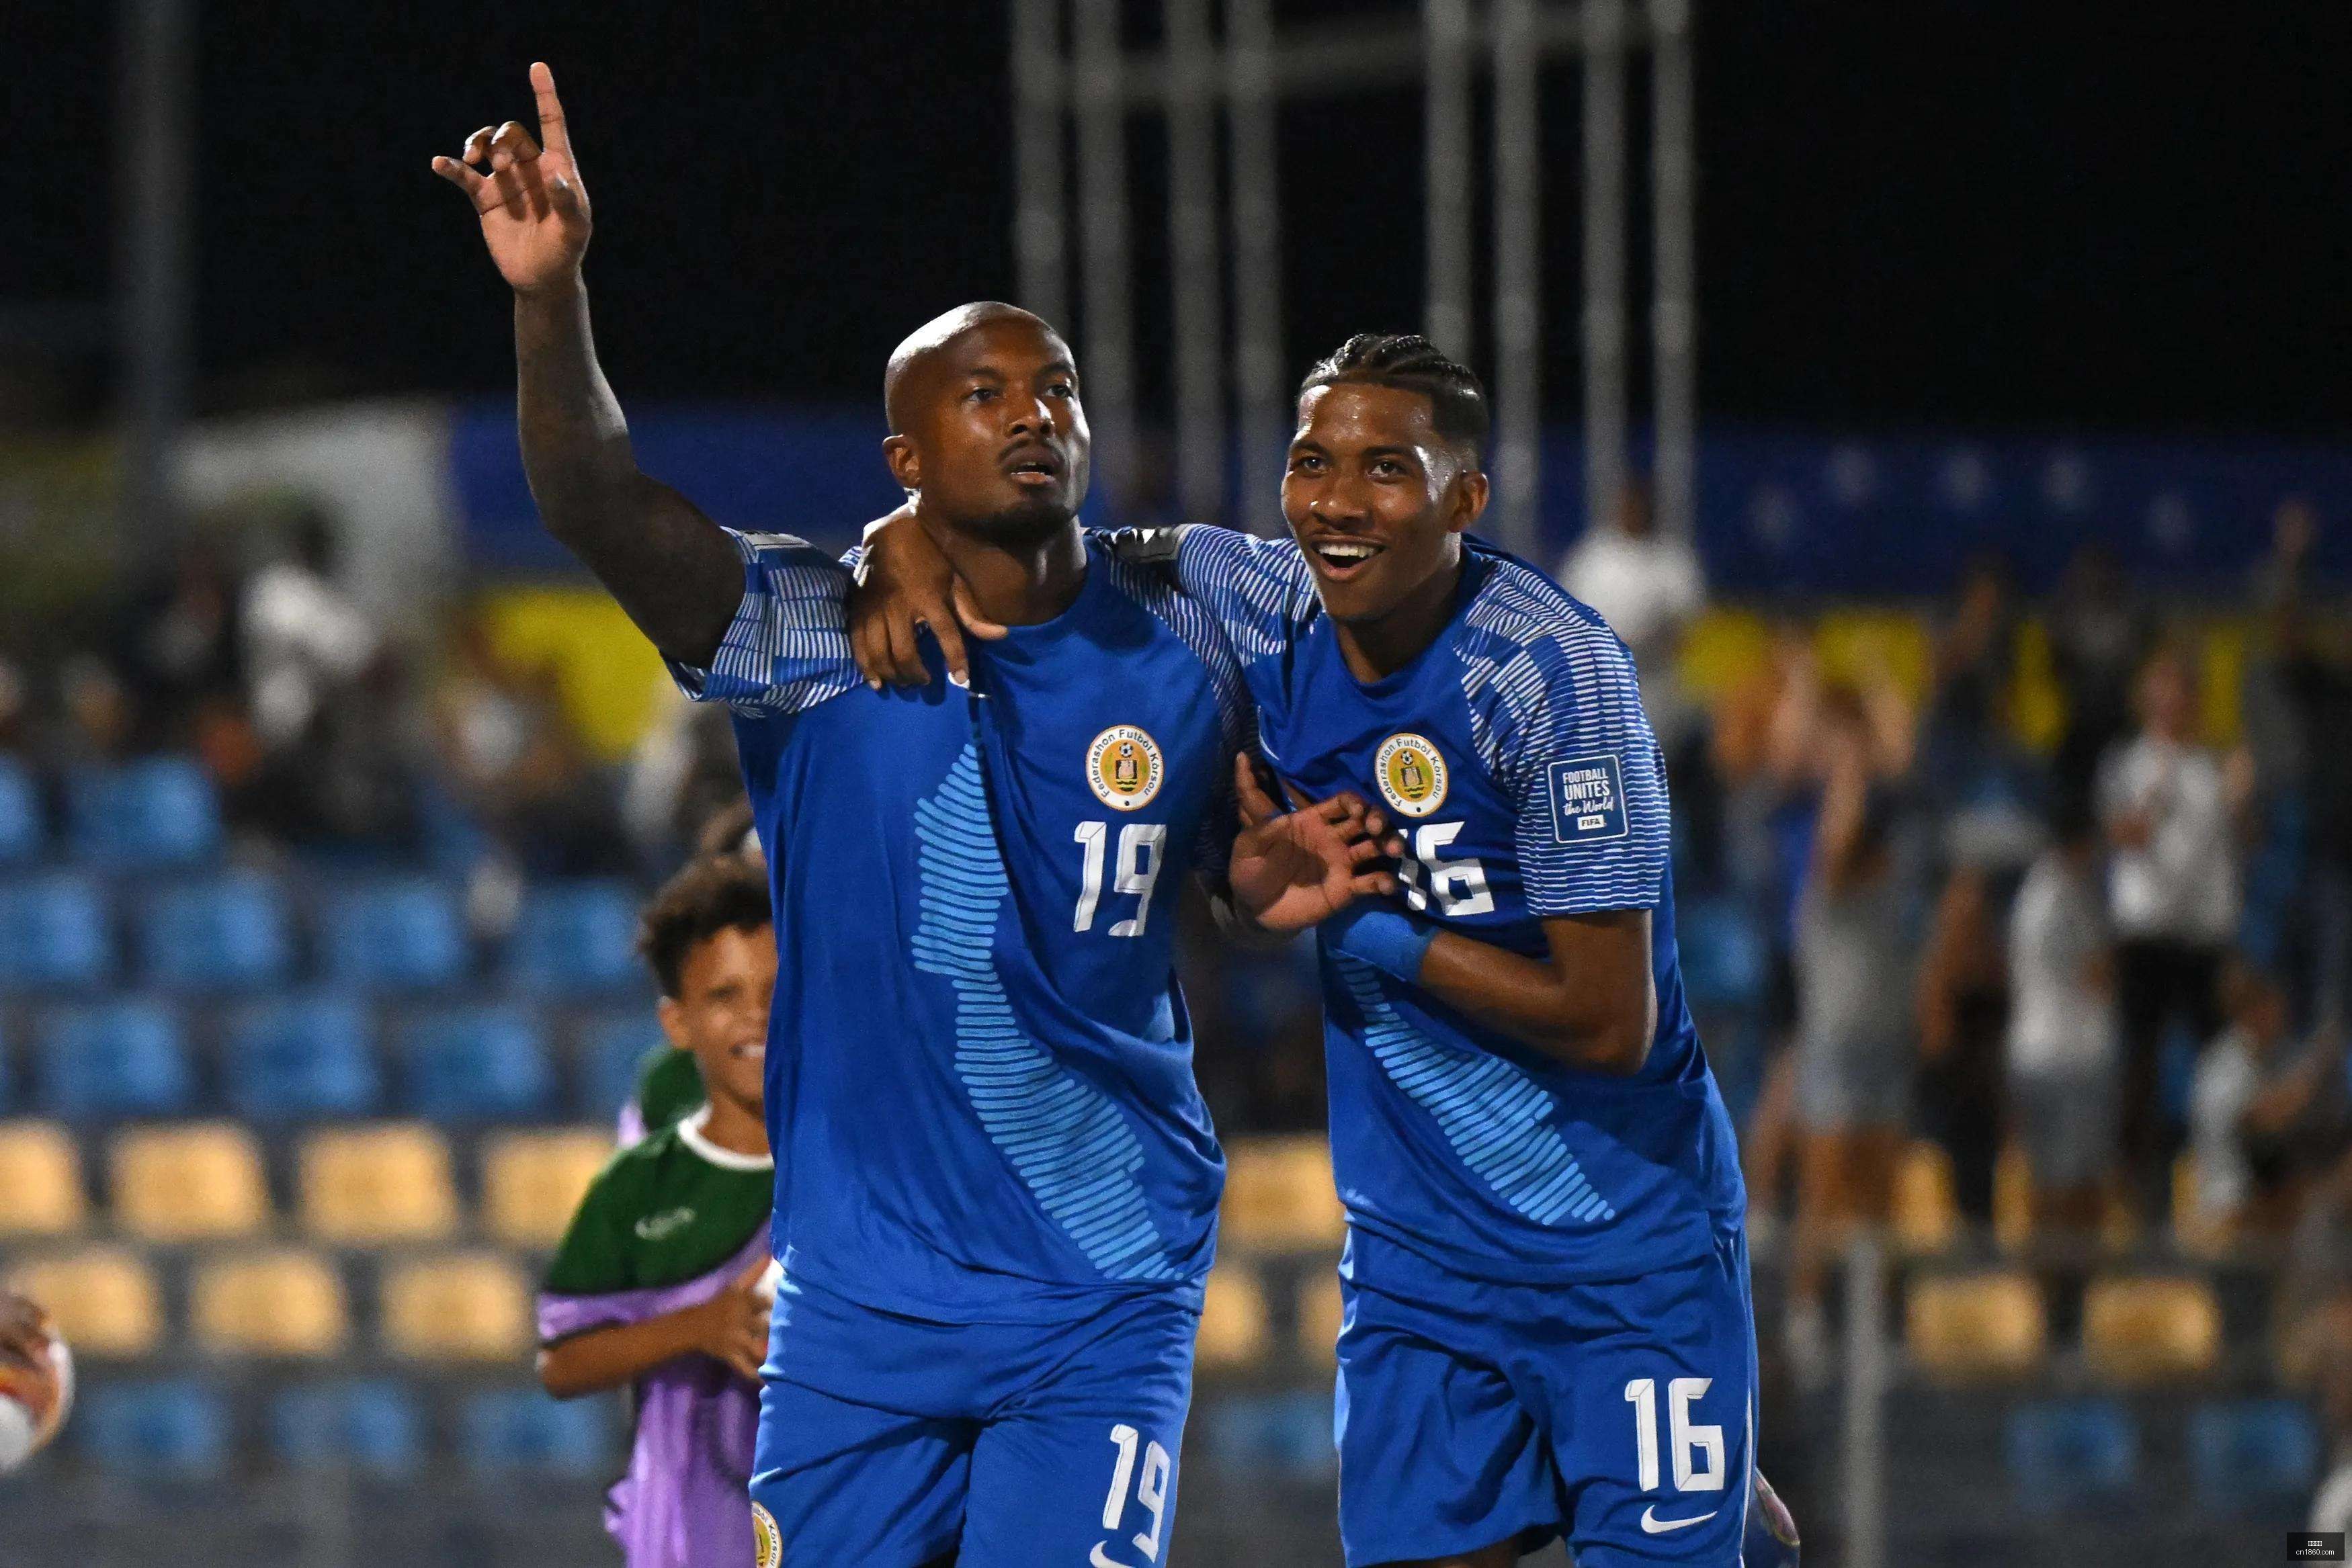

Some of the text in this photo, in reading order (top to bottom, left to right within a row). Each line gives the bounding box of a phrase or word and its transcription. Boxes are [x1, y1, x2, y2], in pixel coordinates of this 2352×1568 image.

[1092, 734, 1115, 797] Federashon
[1380, 744, 1402, 807] Federashon
[1562, 768, 1609, 784] FOOTBALL
[1564, 780, 1610, 801] UNITES
[1562, 797, 1614, 816] the World
[1581, 818, 1601, 827] FIFA
[1073, 821, 1167, 937] 19
[1625, 1377, 1725, 1492] 16
[1103, 1424, 1171, 1563] 19
